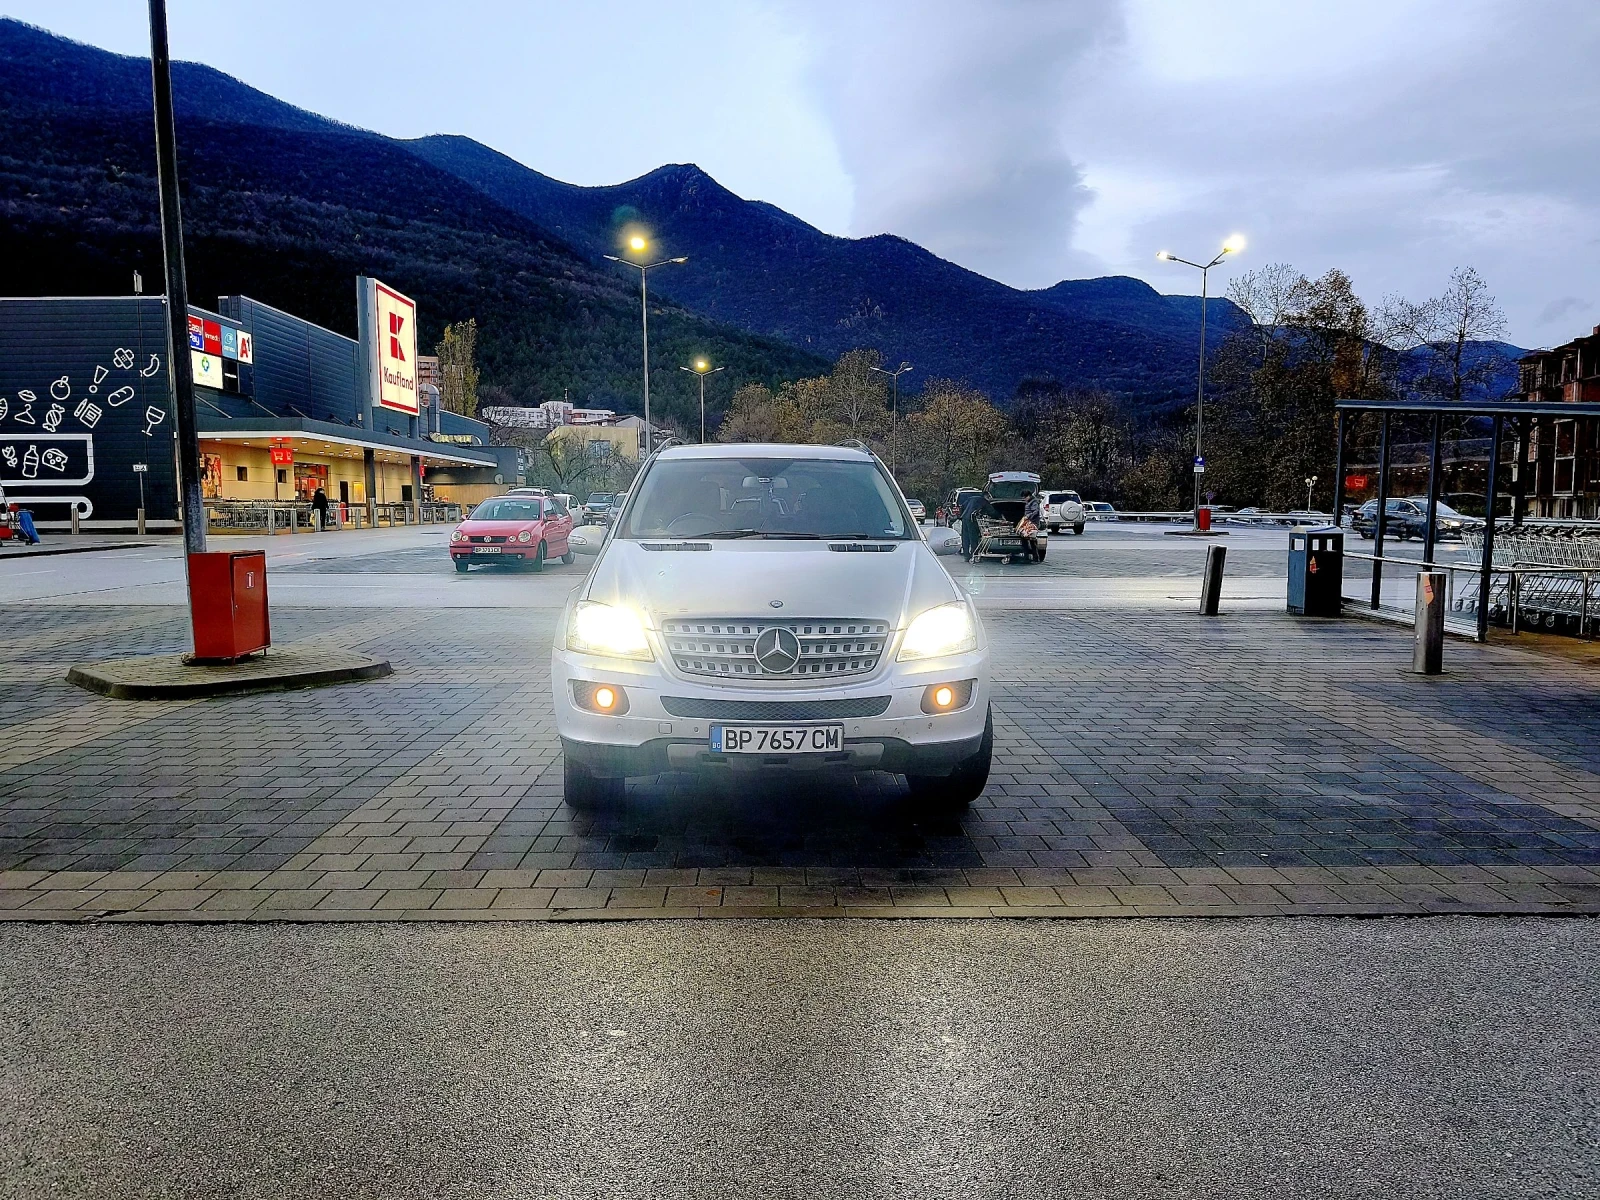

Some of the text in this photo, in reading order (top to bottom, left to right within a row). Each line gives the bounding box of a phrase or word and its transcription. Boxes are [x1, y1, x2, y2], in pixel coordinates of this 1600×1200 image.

[240, 337, 251, 359] A1
[384, 366, 414, 391] Kaufland
[725, 729, 752, 750] BP
[757, 730, 808, 751] 7657
[811, 728, 839, 750] CM
